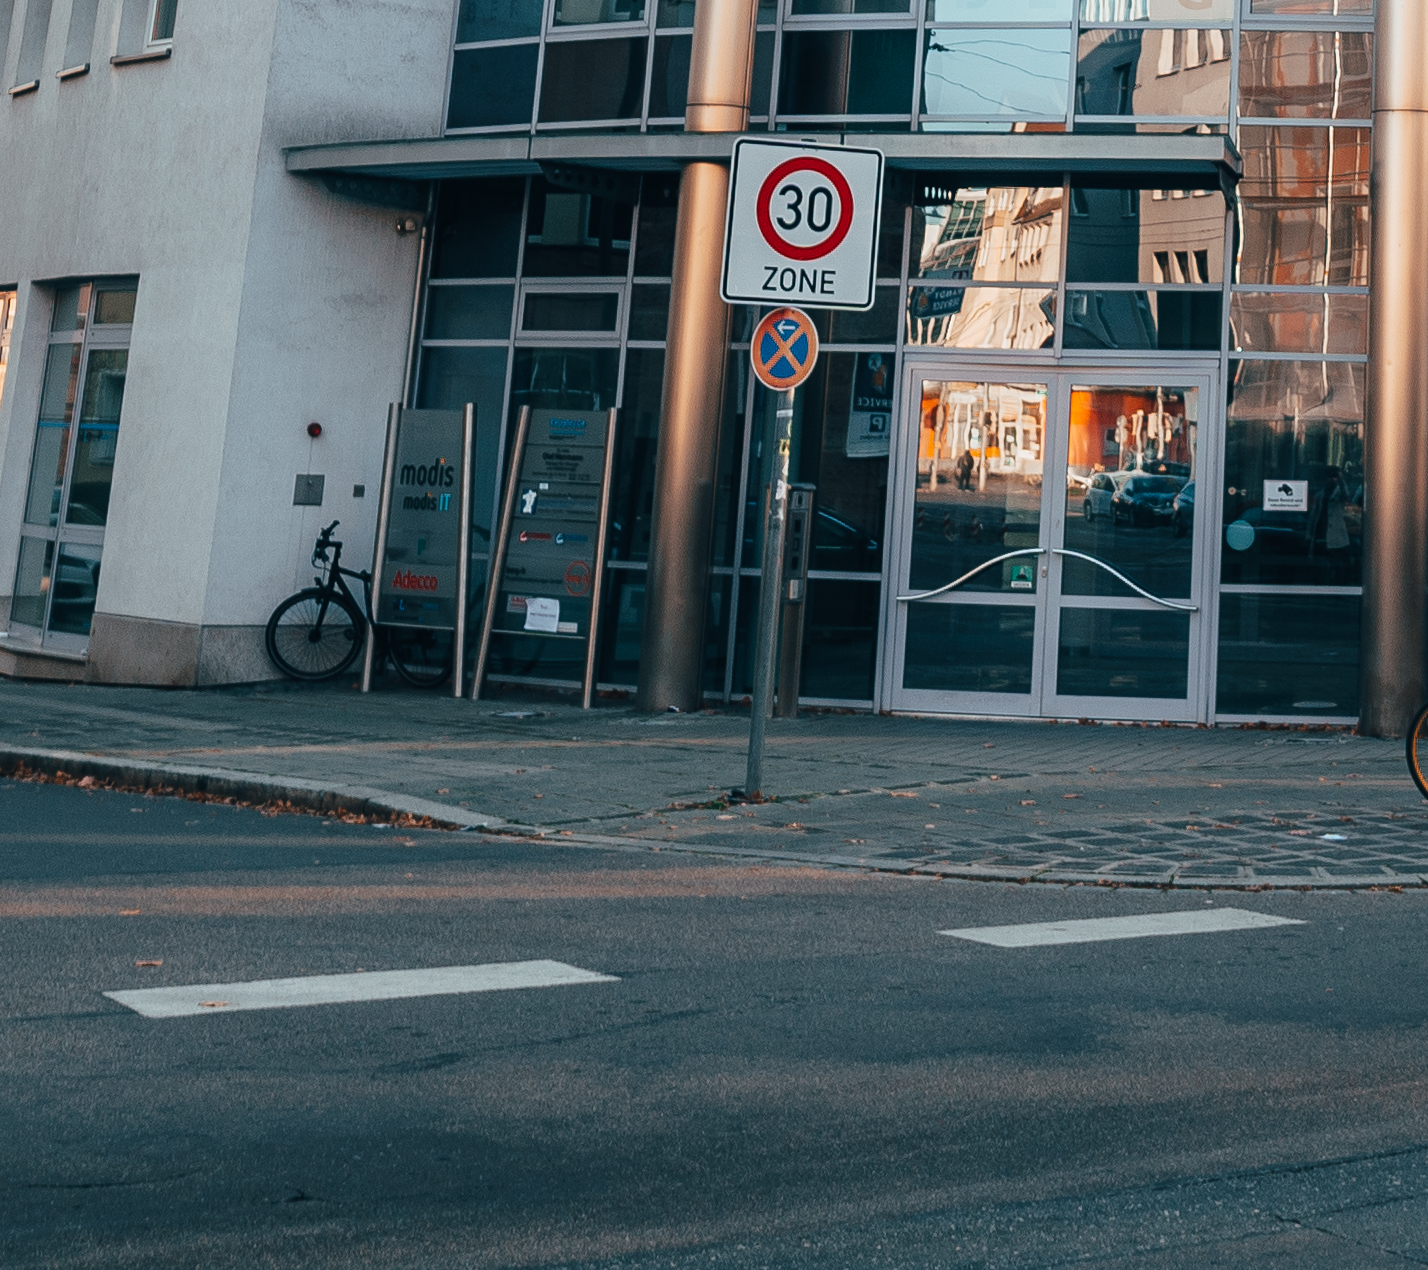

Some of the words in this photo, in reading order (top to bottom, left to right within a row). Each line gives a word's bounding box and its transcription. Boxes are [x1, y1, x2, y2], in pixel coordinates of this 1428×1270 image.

[776, 184, 833, 232] 30
[761, 266, 837, 294] ZONE
[399, 456, 454, 487] modis
[403, 492, 437, 510] modis
[438, 492, 452, 511] IT
[392, 569, 438, 592] Adecco
